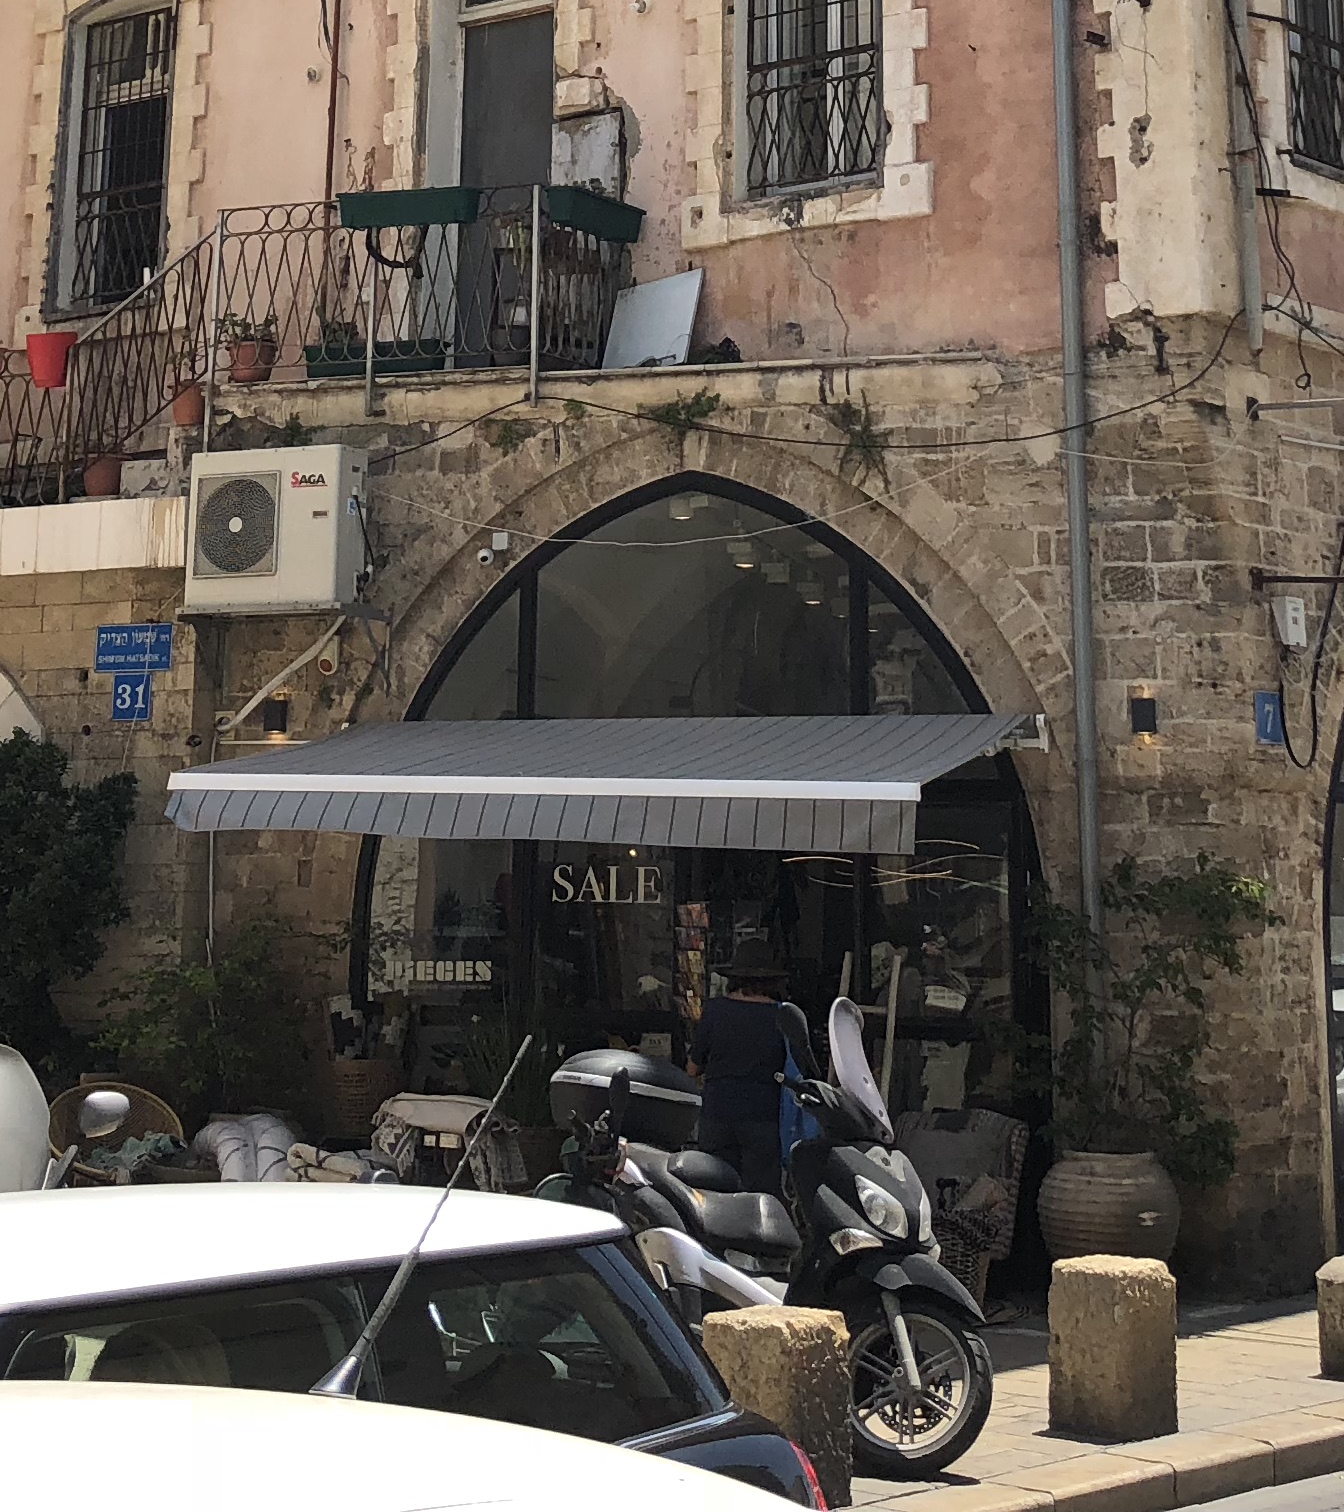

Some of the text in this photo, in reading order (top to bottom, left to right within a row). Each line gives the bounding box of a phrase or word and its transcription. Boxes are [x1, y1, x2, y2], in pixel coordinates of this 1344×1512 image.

[291, 471, 326, 487] SAGA
[116, 684, 146, 709] 31
[1264, 702, 1274, 734] 7
[551, 864, 662, 904] SALE
